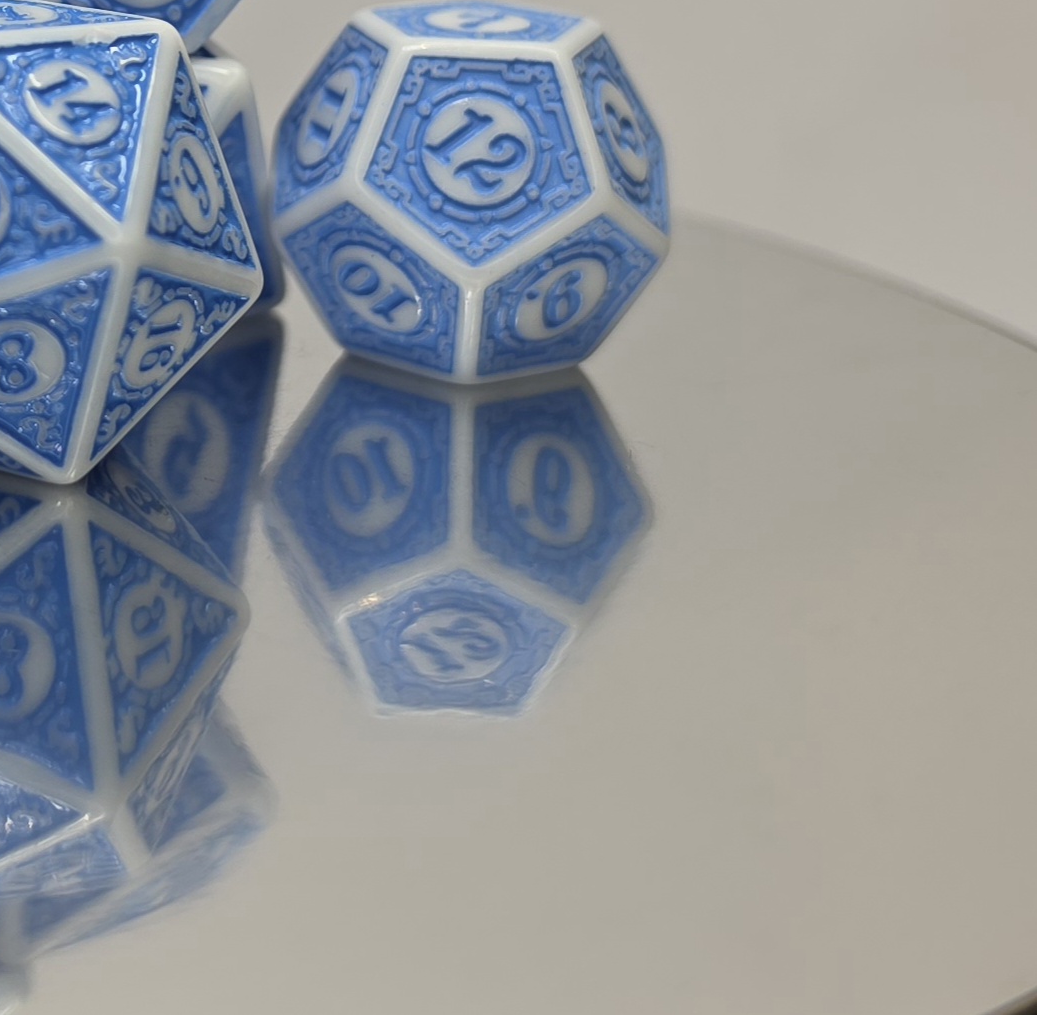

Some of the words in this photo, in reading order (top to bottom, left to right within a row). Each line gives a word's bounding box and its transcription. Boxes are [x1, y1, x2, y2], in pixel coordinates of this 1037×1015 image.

[27, 68, 117, 135] 14
[308, 85, 349, 145] 11
[424, 108, 529, 195] 12
[337, 264, 417, 325] 10
